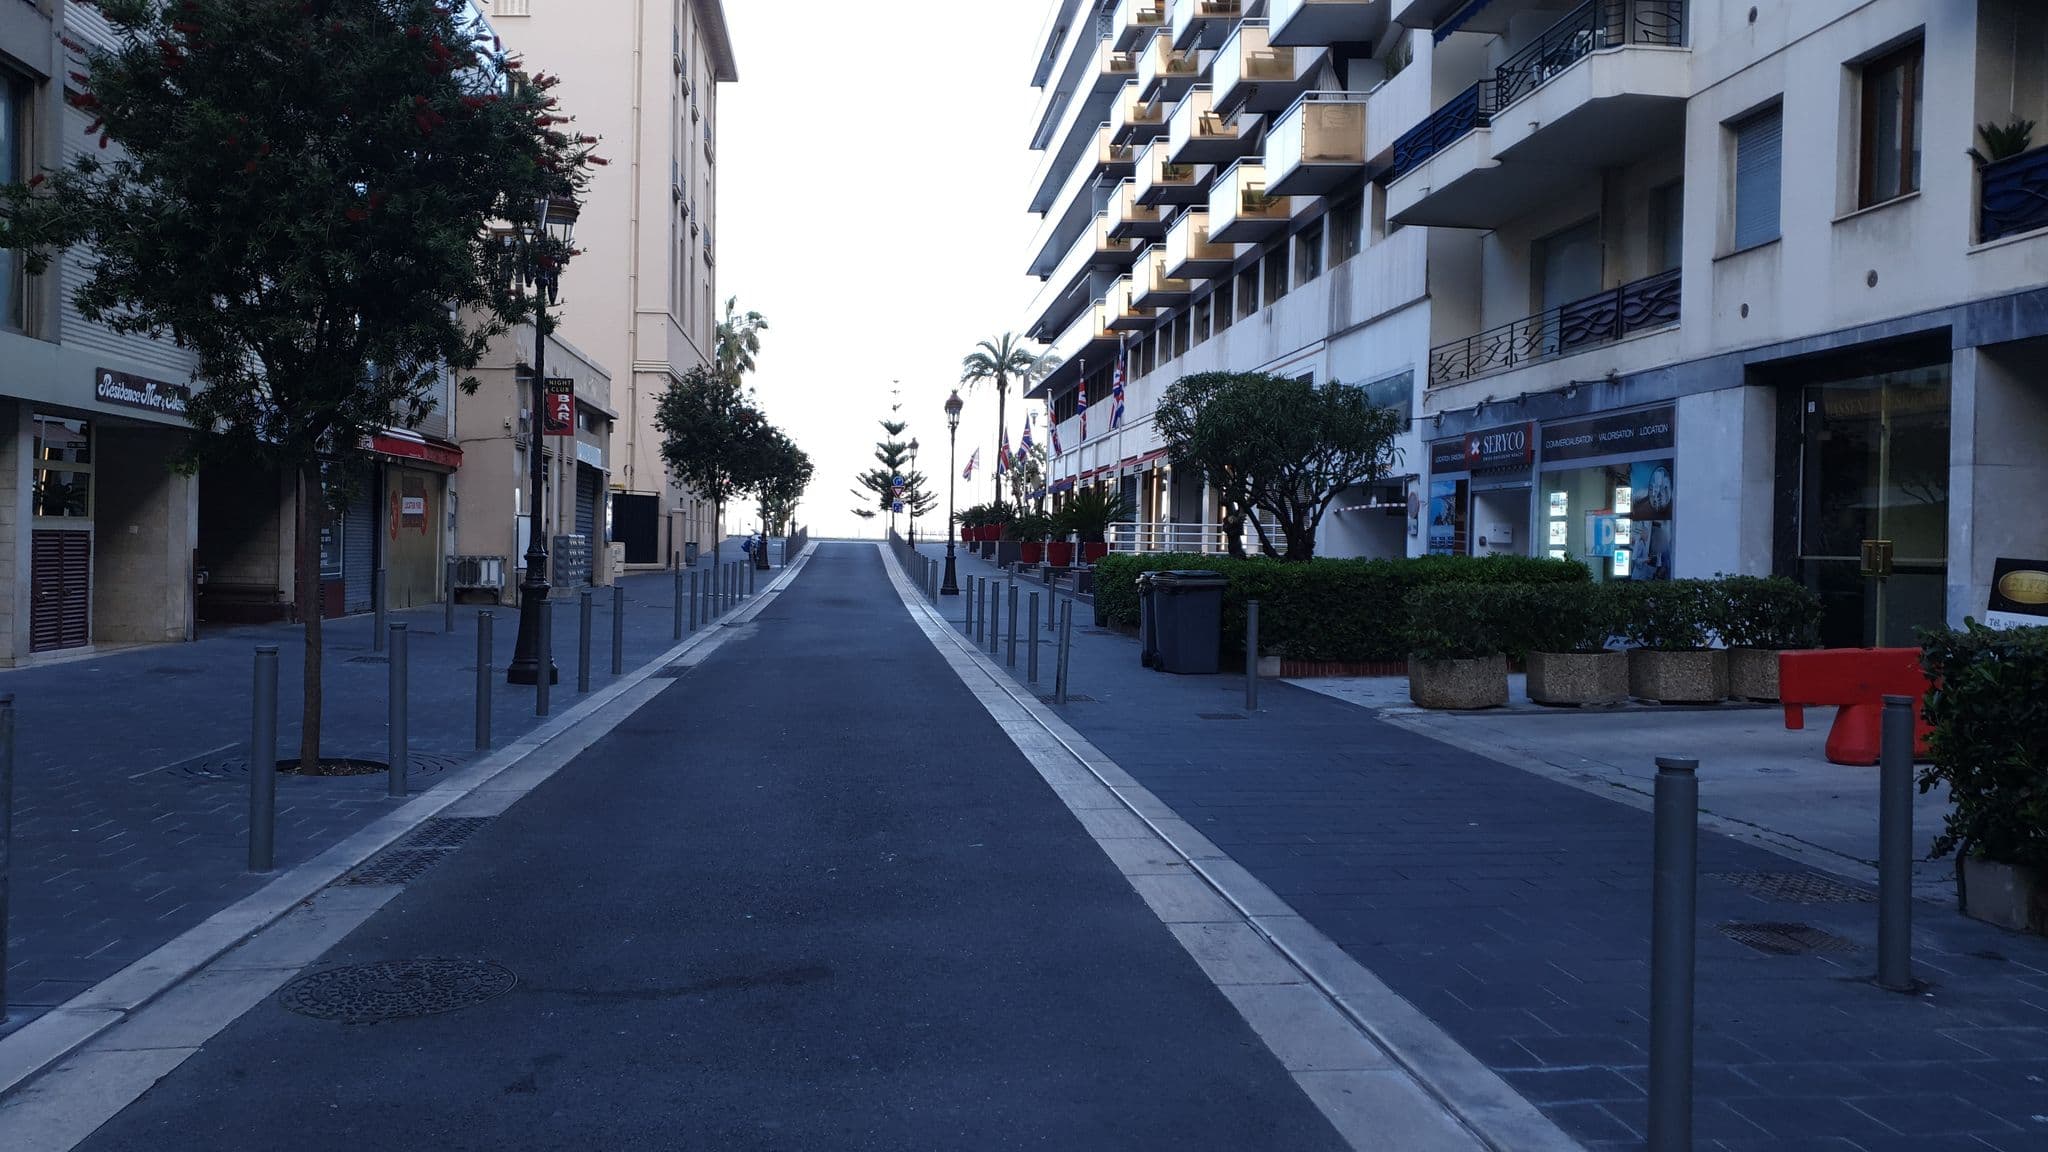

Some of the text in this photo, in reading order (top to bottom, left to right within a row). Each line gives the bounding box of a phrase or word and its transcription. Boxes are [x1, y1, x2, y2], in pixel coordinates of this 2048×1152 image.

[98, 373, 141, 403] Résidence
[141, 382, 162, 408] Mer
[557, 394, 570, 421] BAR
[1483, 430, 1525, 455] SERYCO
[1598, 429, 1634, 441] VALORISATION
[1639, 423, 1670, 436] LOCATION
